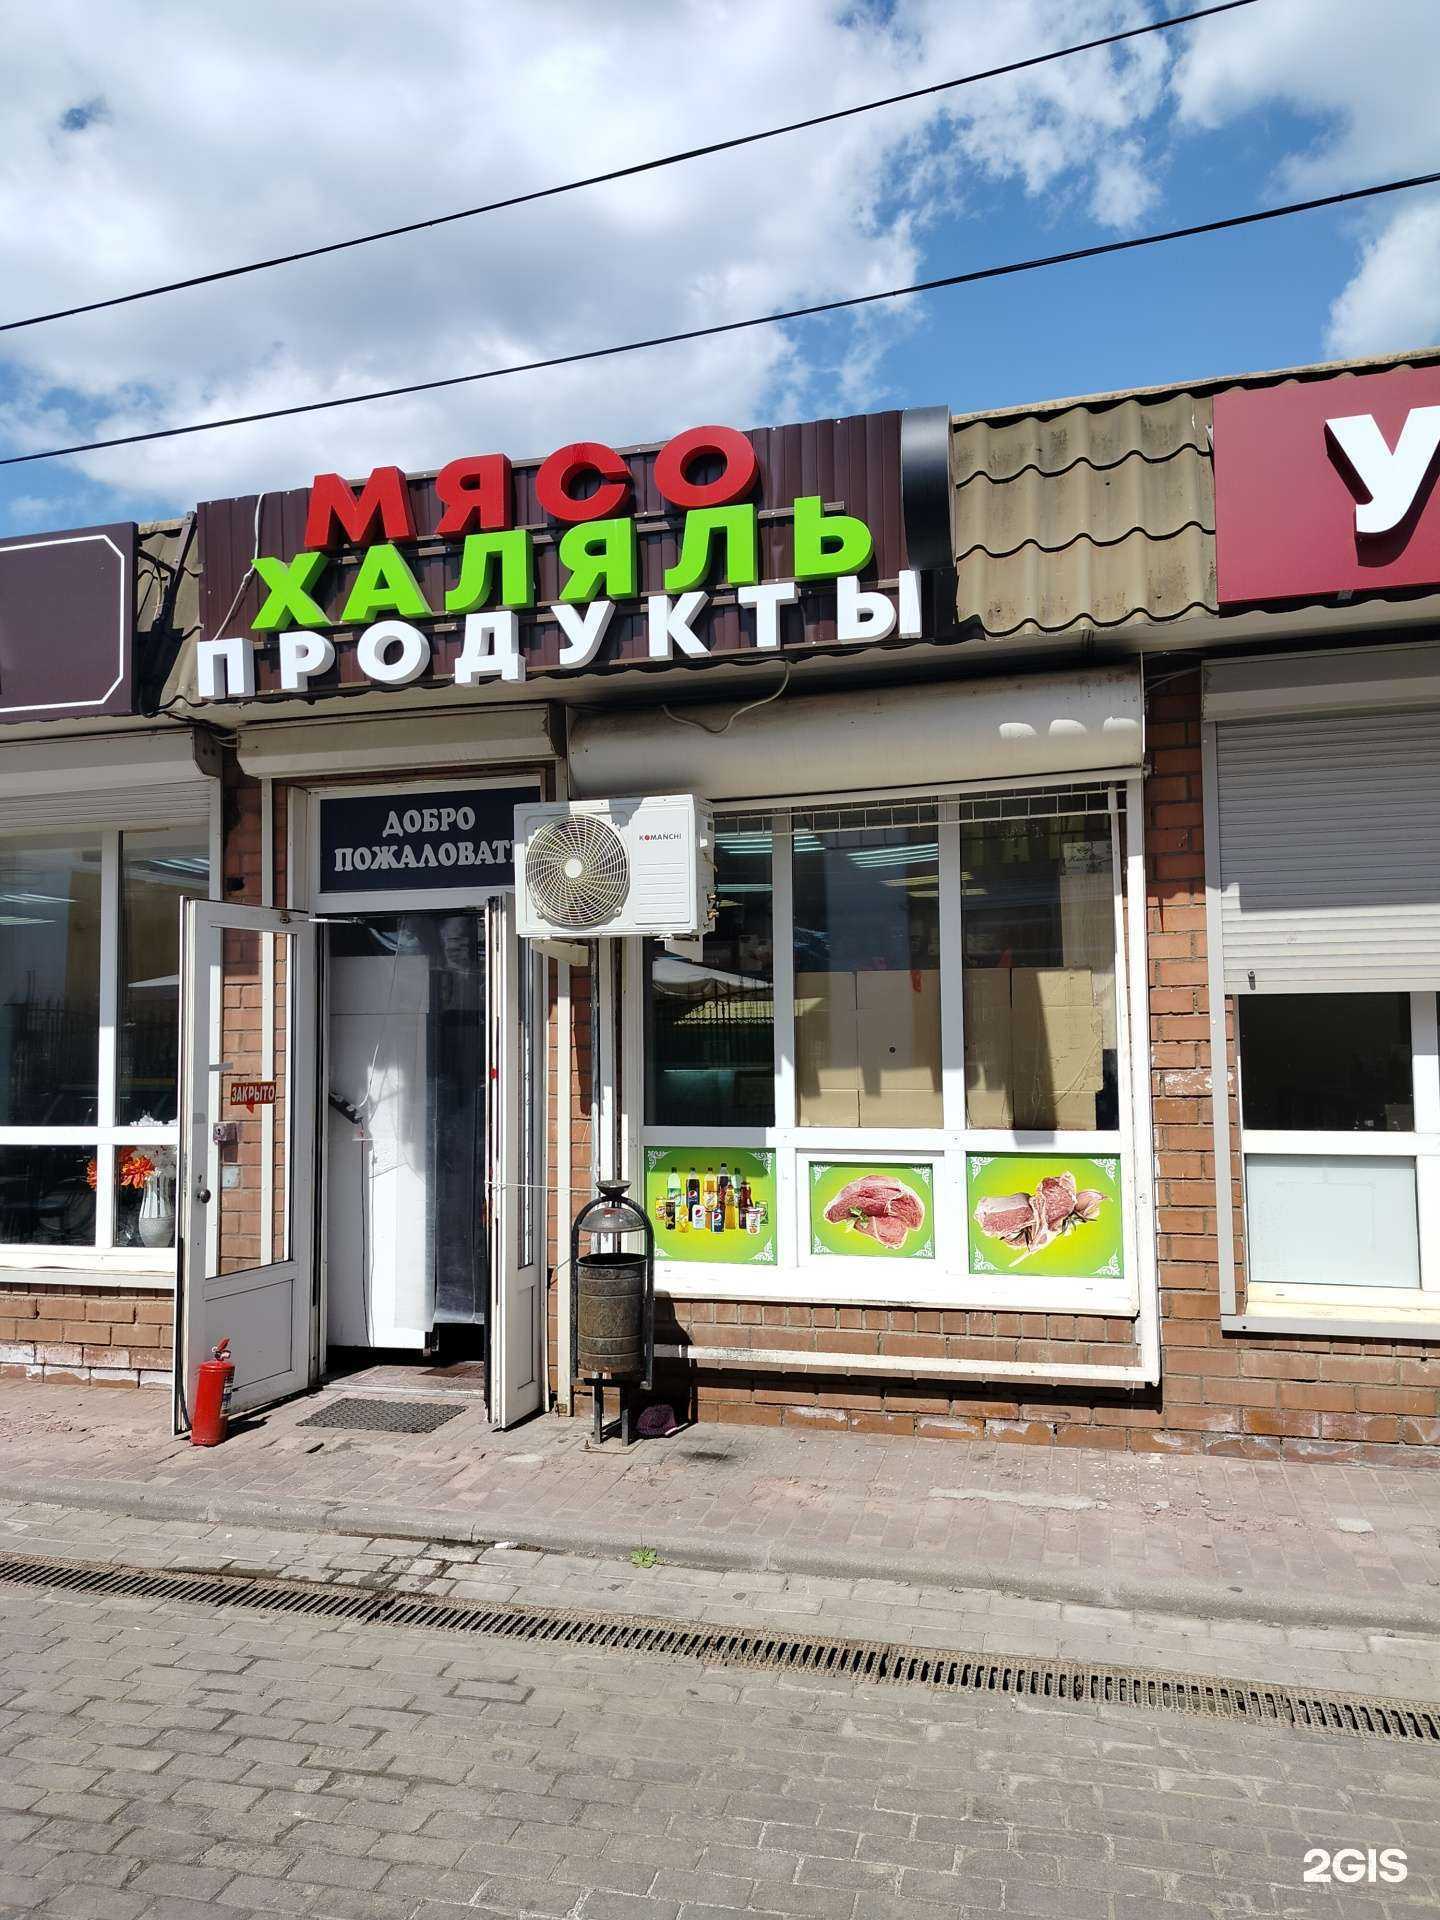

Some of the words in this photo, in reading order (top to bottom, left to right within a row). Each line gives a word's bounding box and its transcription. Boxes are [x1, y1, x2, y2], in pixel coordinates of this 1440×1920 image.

[304, 425, 760, 549] МЯСО
[251, 496, 872, 630] ХАЛЯЛЬ
[197, 568, 921, 698] ПРОДУКТЫ
[382, 806, 476, 838] ДОБРО
[639, 832, 682, 841] KOMANCHI
[334, 840, 515, 872] ПОЖАЛОВАТ
[231, 1084, 275, 1102] ЗАКРЫТО
